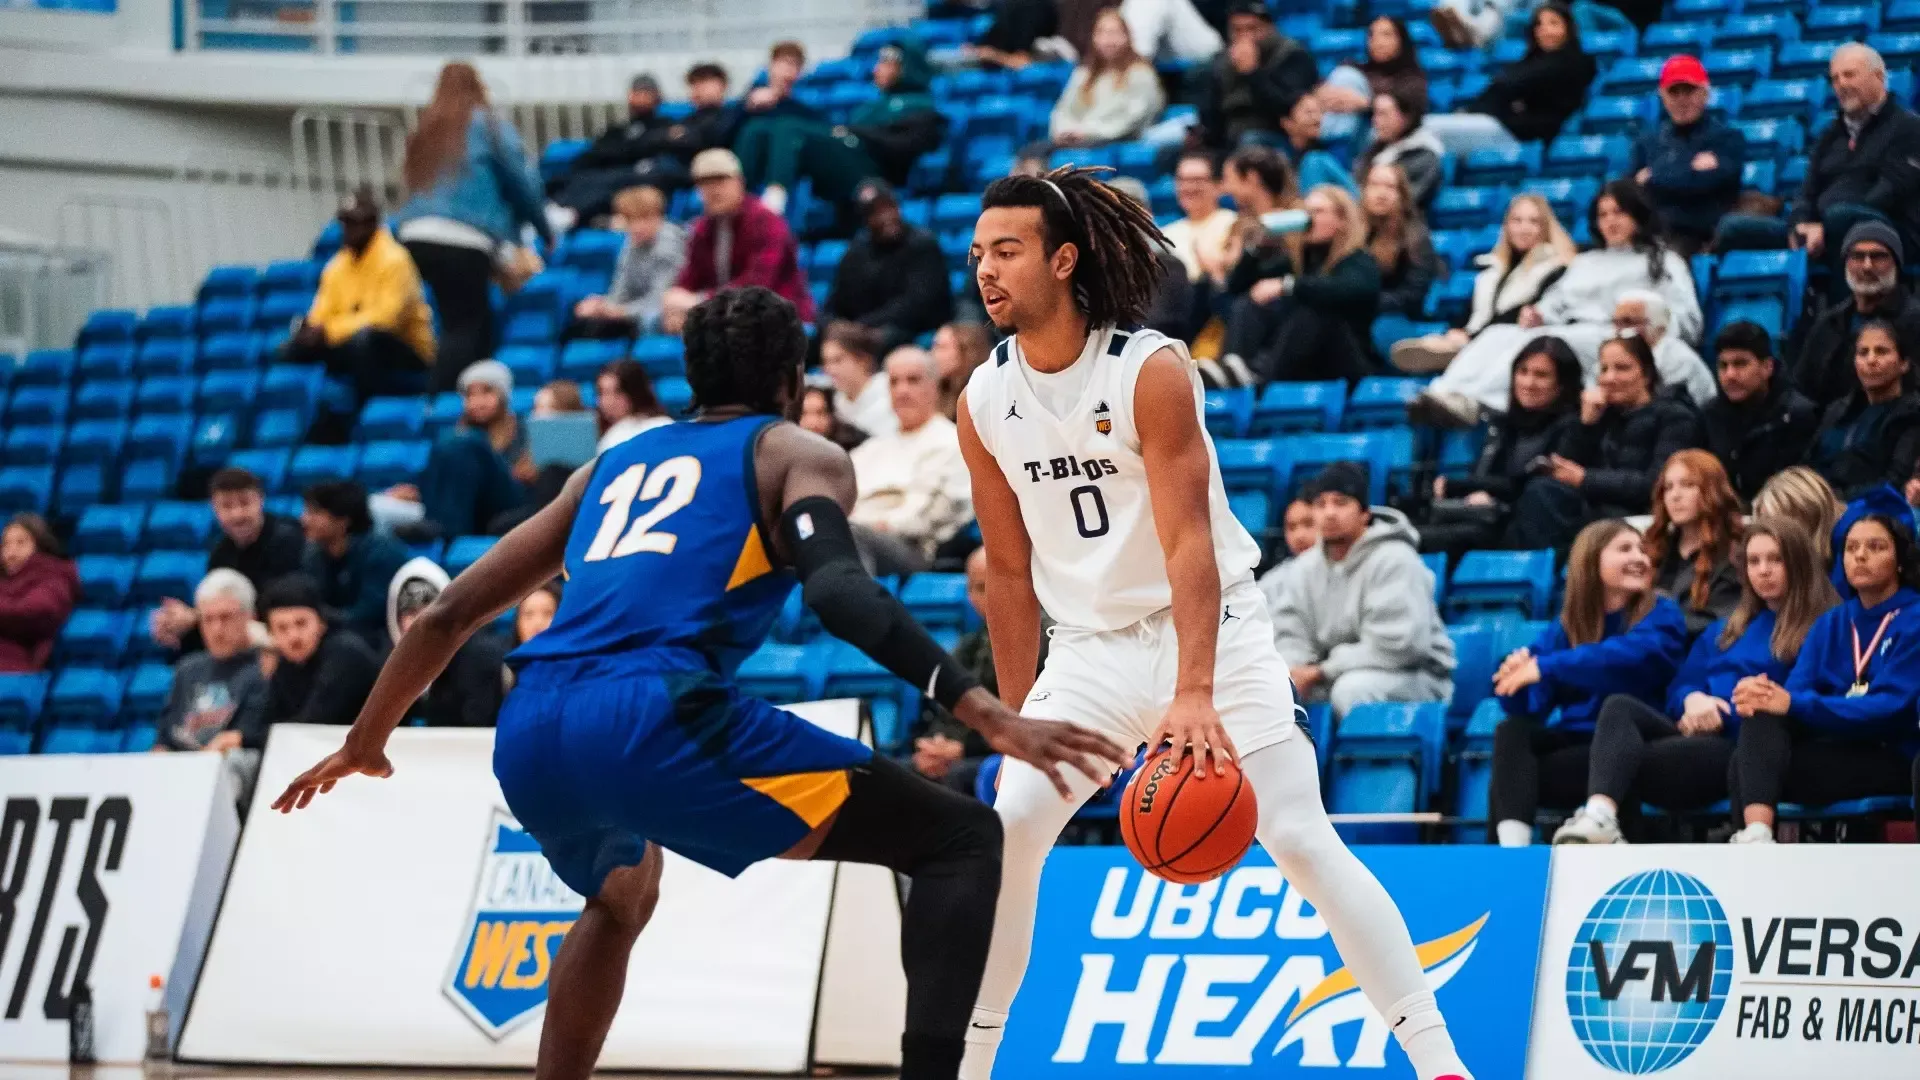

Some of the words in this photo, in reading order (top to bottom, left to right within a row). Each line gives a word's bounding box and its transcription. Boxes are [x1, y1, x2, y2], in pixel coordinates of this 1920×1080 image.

[584, 455, 702, 562] 12
[1070, 485, 1109, 538] 0
[1590, 941, 1716, 1003] VFM
[1736, 996, 1791, 1039] FAB
[1802, 997, 1824, 1041] &
